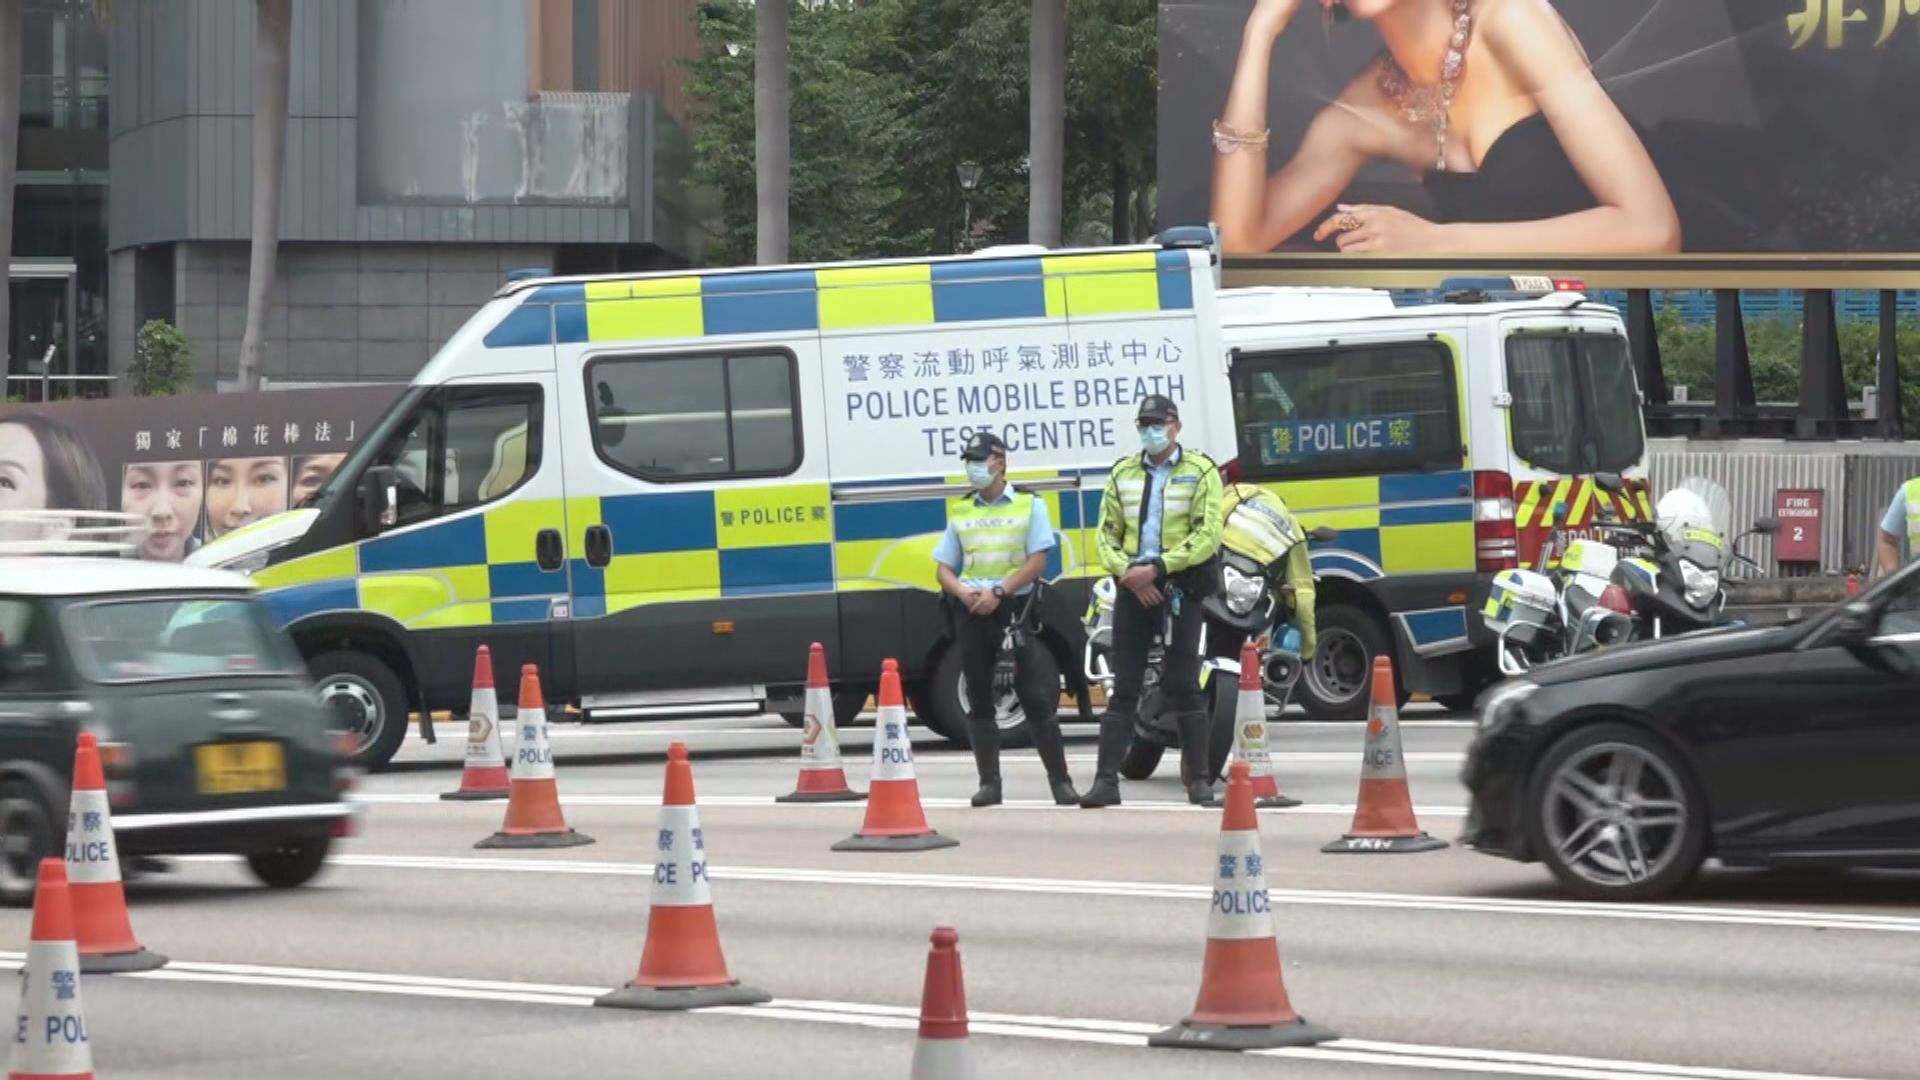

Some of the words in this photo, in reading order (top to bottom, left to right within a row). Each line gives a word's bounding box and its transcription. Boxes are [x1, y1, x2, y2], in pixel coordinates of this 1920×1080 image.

[842, 338, 1183, 382] 警察流動呼氣測試中心
[847, 388, 949, 420] POLICE
[958, 380, 1065, 414] MOBILE
[1075, 374, 1185, 408] BREATH
[1003, 418, 1116, 451] CENTRE
[1299, 420, 1382, 450] POLICE
[740, 506, 804, 525] POLICE
[1786, 498, 1810, 508] FIRE
[1793, 526, 1804, 542] 2
[1219, 851, 1262, 879] 警察
[1211, 889, 1272, 915] POLICE
